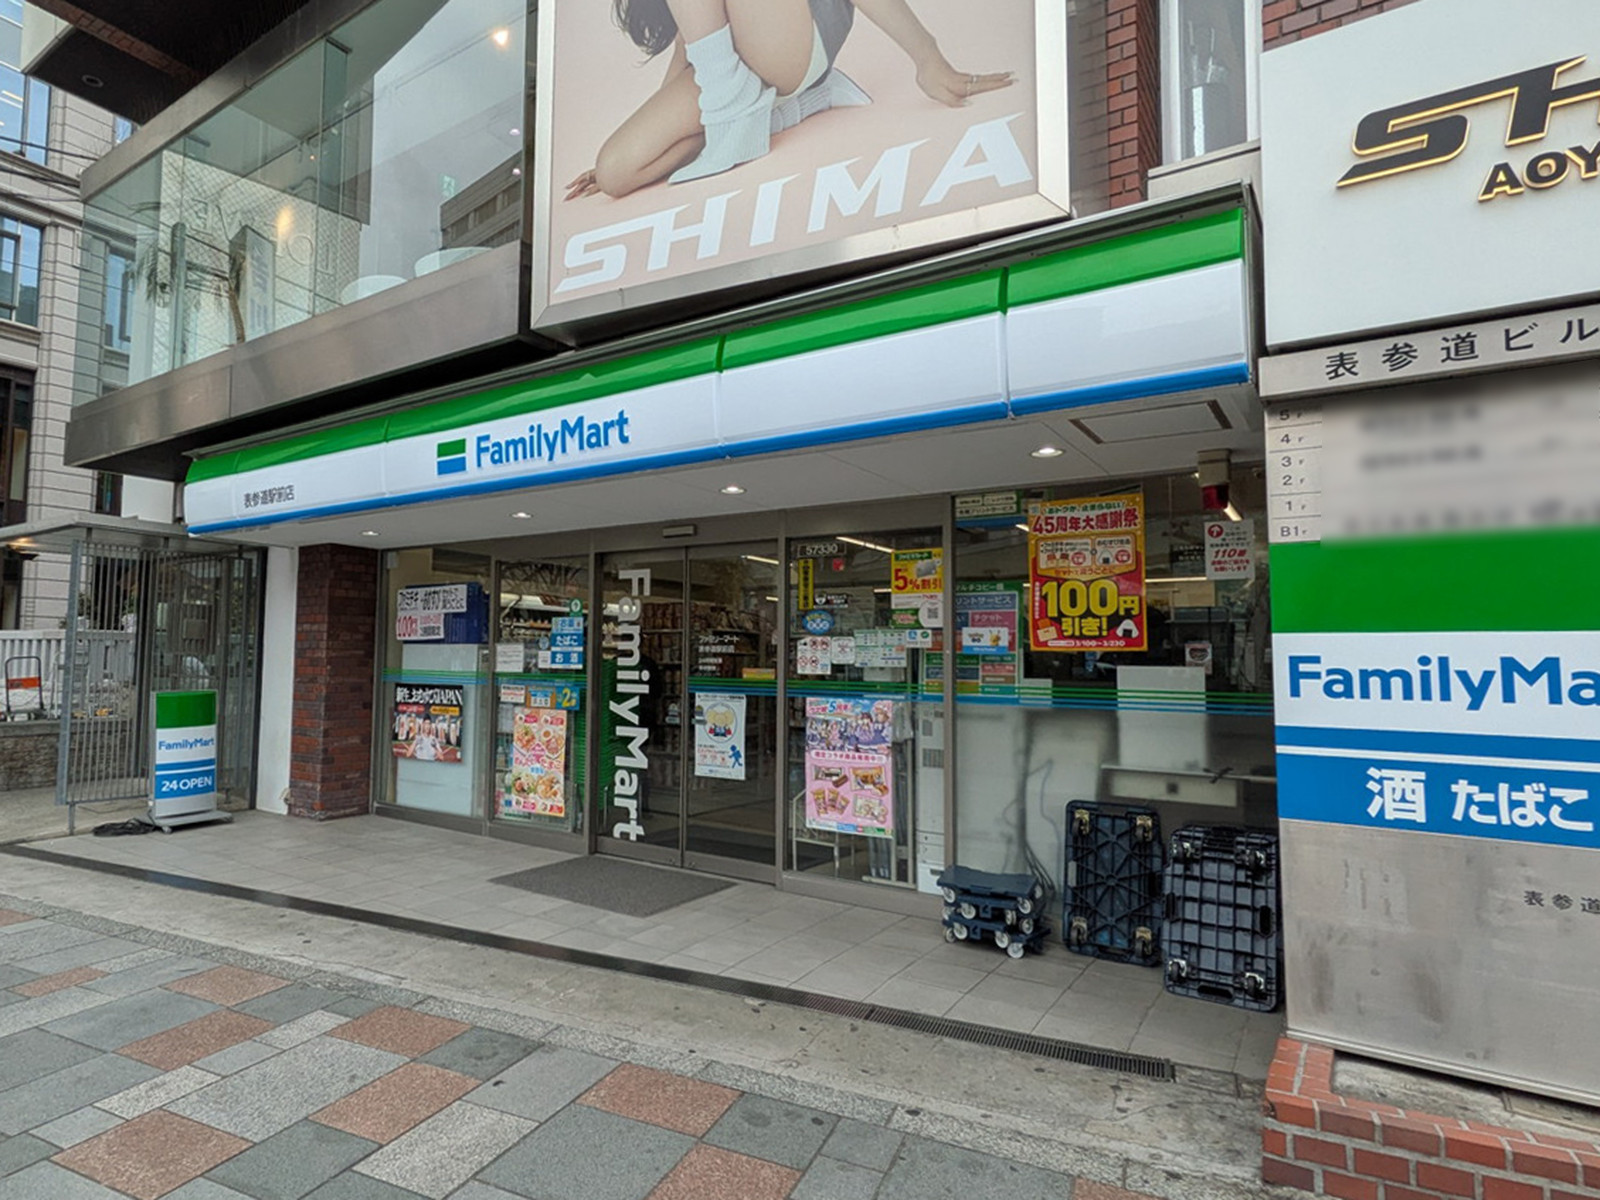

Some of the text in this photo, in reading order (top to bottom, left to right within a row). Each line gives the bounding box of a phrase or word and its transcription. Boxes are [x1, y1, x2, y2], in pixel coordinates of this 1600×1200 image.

[554, 111, 1033, 293] SHIMA
[1325, 318, 1600, 380] 表参道ビル
[476, 409, 629, 468] FamilyMart
[1033, 507, 1139, 534] 45周年大感謝祭
[894, 568, 942, 591] 5%割引
[1041, 579, 1140, 618] 100円
[556, 635, 579, 646] たばこ
[1061, 616, 1108, 637] 引き!
[1288, 655, 1600, 711] FamilyMa
[608, 567, 651, 842] FamilyMart
[158, 738, 215, 751] FamilyMart
[161, 776, 212, 792] 24 OPEN
[1366, 766, 1594, 832] 酒 たばこ
[1524, 890, 1600, 915] 表参道
